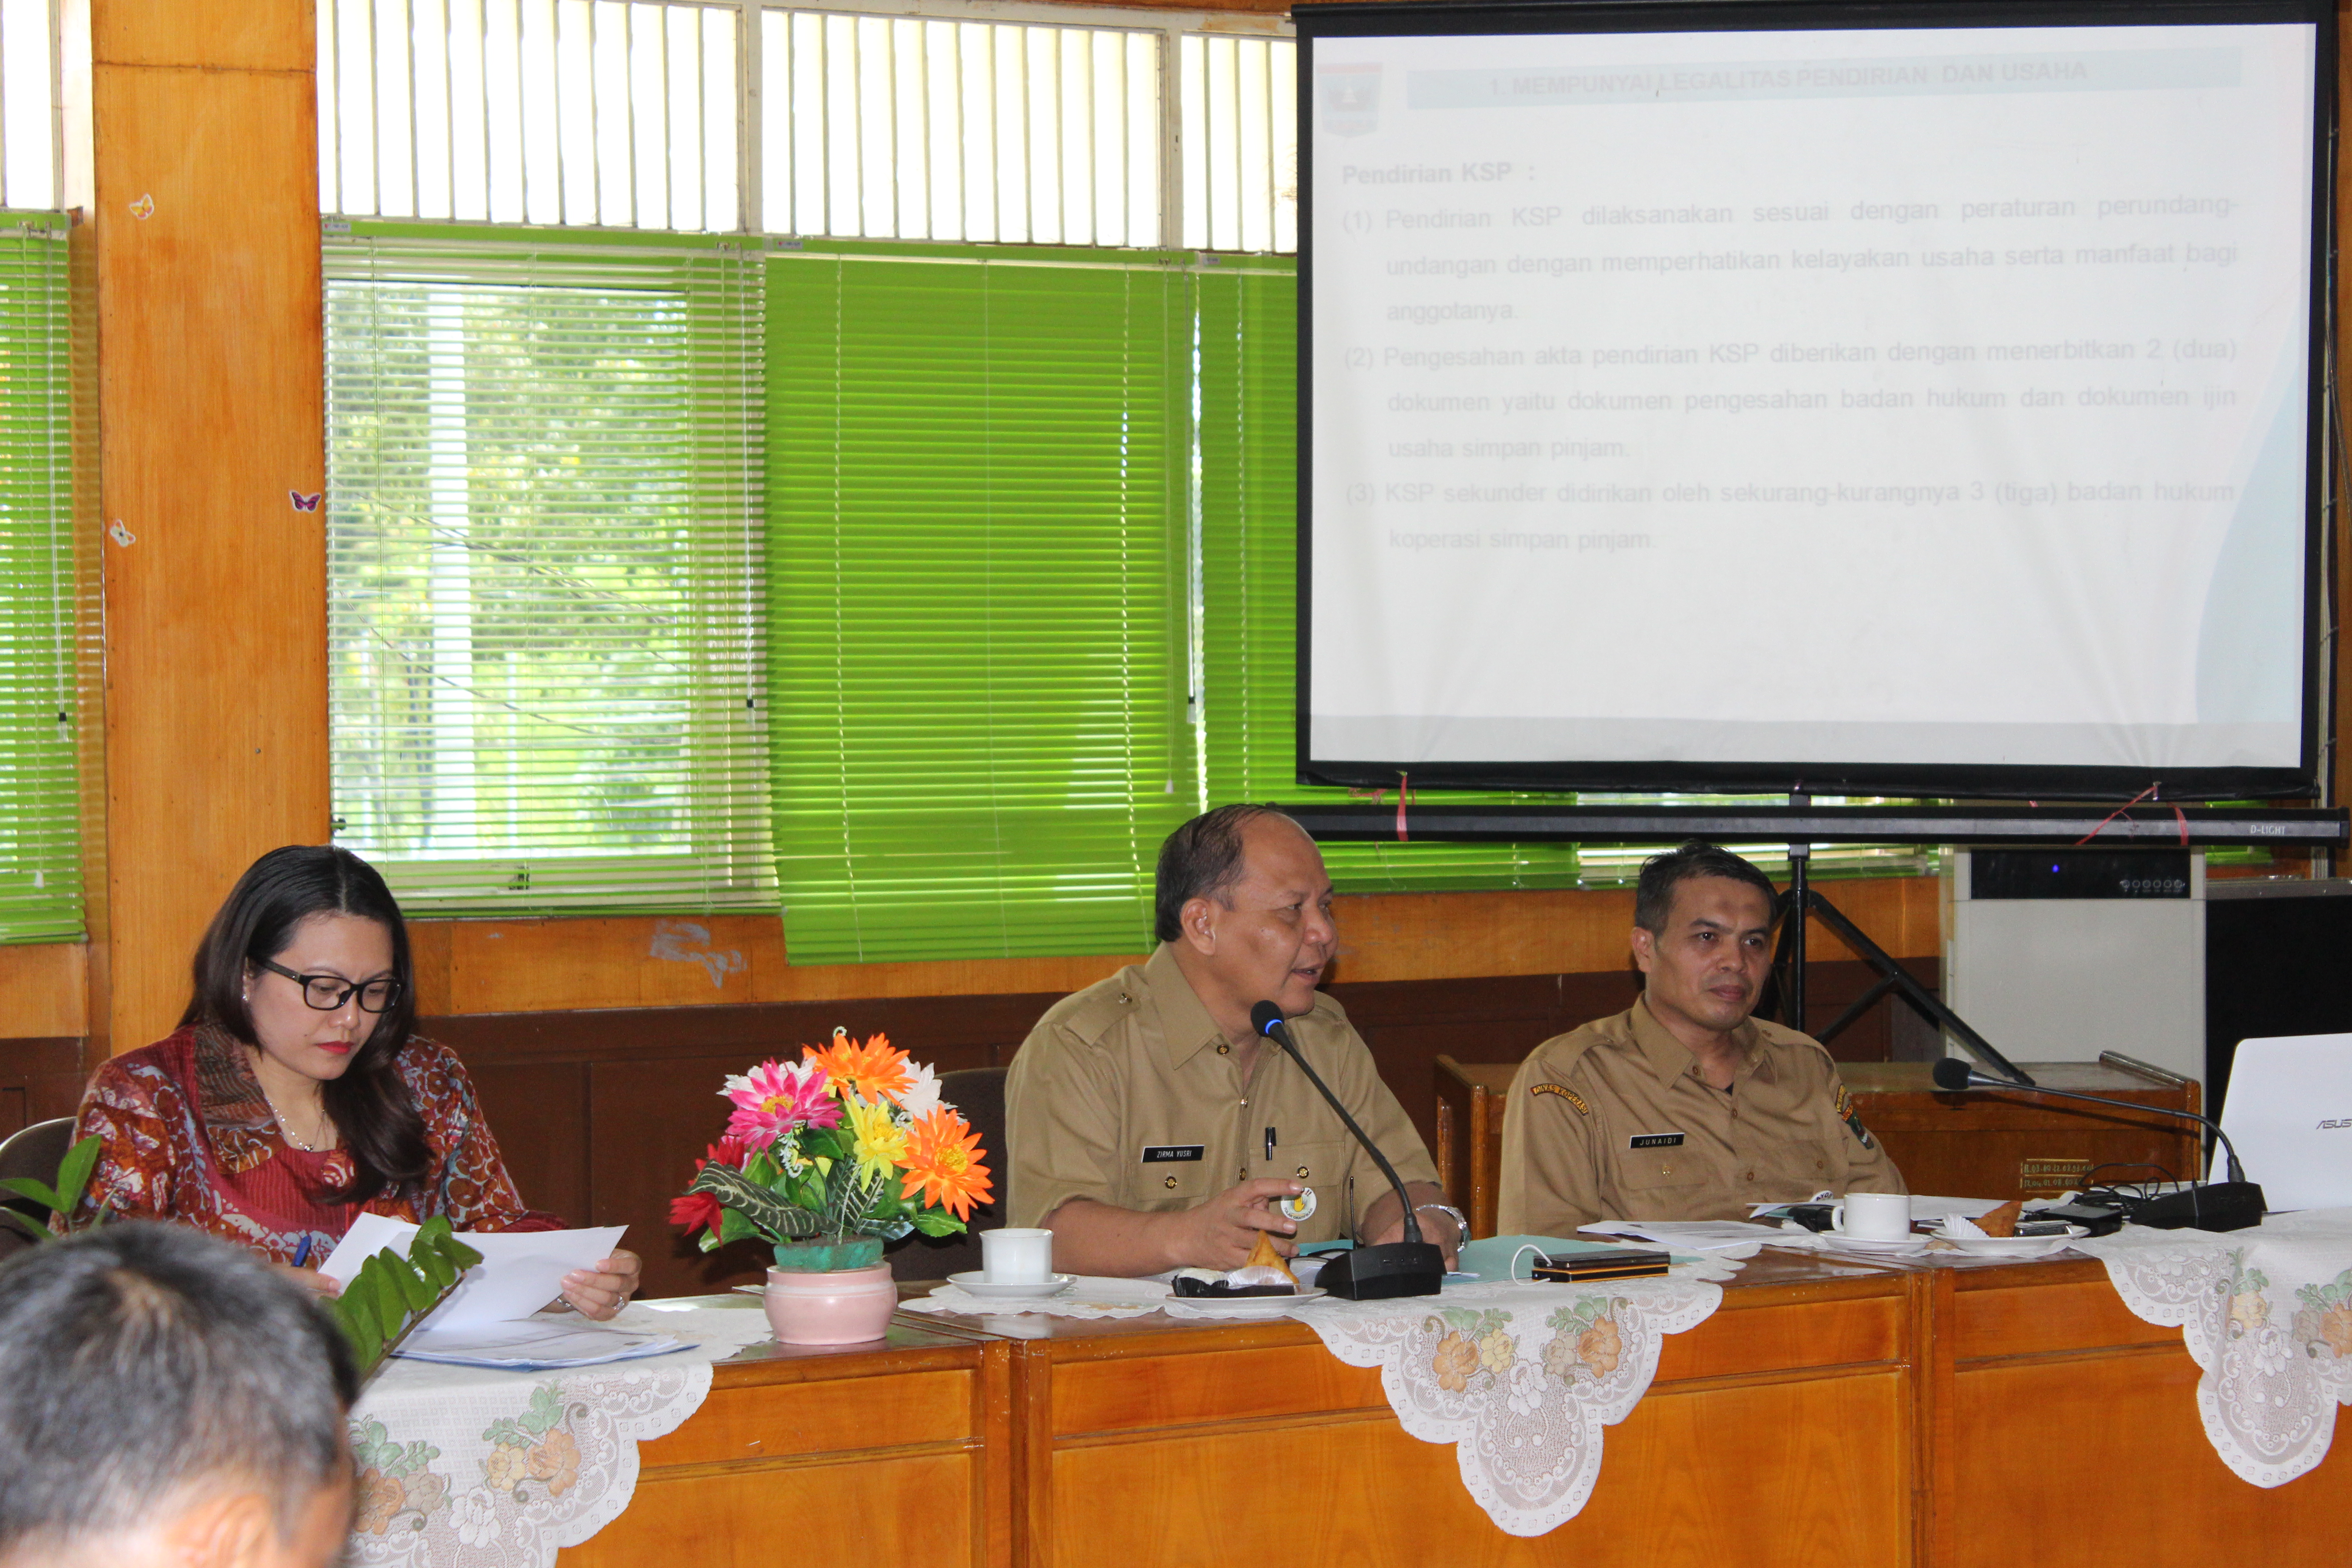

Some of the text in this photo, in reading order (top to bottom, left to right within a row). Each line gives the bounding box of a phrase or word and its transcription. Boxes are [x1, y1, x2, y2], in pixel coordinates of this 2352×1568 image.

[1489, 61, 2088, 96] 1. MEMPUNYAI LEGALITAS PENDIRIAN DAN USAHA
[1342, 164, 1453, 185] Pendirian
[1461, 161, 1513, 182] KSP
[1341, 194, 2239, 234] (1) Pendirian KSP dilaksanakan sesuai dengan peraturan perundang-
[1387, 242, 2238, 280] undangan dengan memperhatikan kelayakan usaha serta manfaat bagi
[1387, 301, 1519, 326] anggotanya.
[1343, 338, 2237, 372] (2) Pengesahan akta pendirian KSP diberikan dengan menerbitkan 2 (dua)
[1387, 385, 2239, 416] dokumen yaitu dokumen pengesahan badan hukum dan dokumen ijin
[1388, 438, 1630, 462] usaha simpan pinjam.
[1345, 480, 2234, 508] (3) KSP sekunder didirikan oleh sekurang-kurangnya 3 (tiga) badan hukum
[1389, 529, 1656, 554] koperasi simpan pinjam.
[2250, 824, 2286, 835] D-LIGHT
[1535, 1084, 1588, 1113] DINAS KOPERASI
[2316, 1119, 2352, 1130] ASUS
[1640, 1137, 1676, 1146] JUNAIDI
